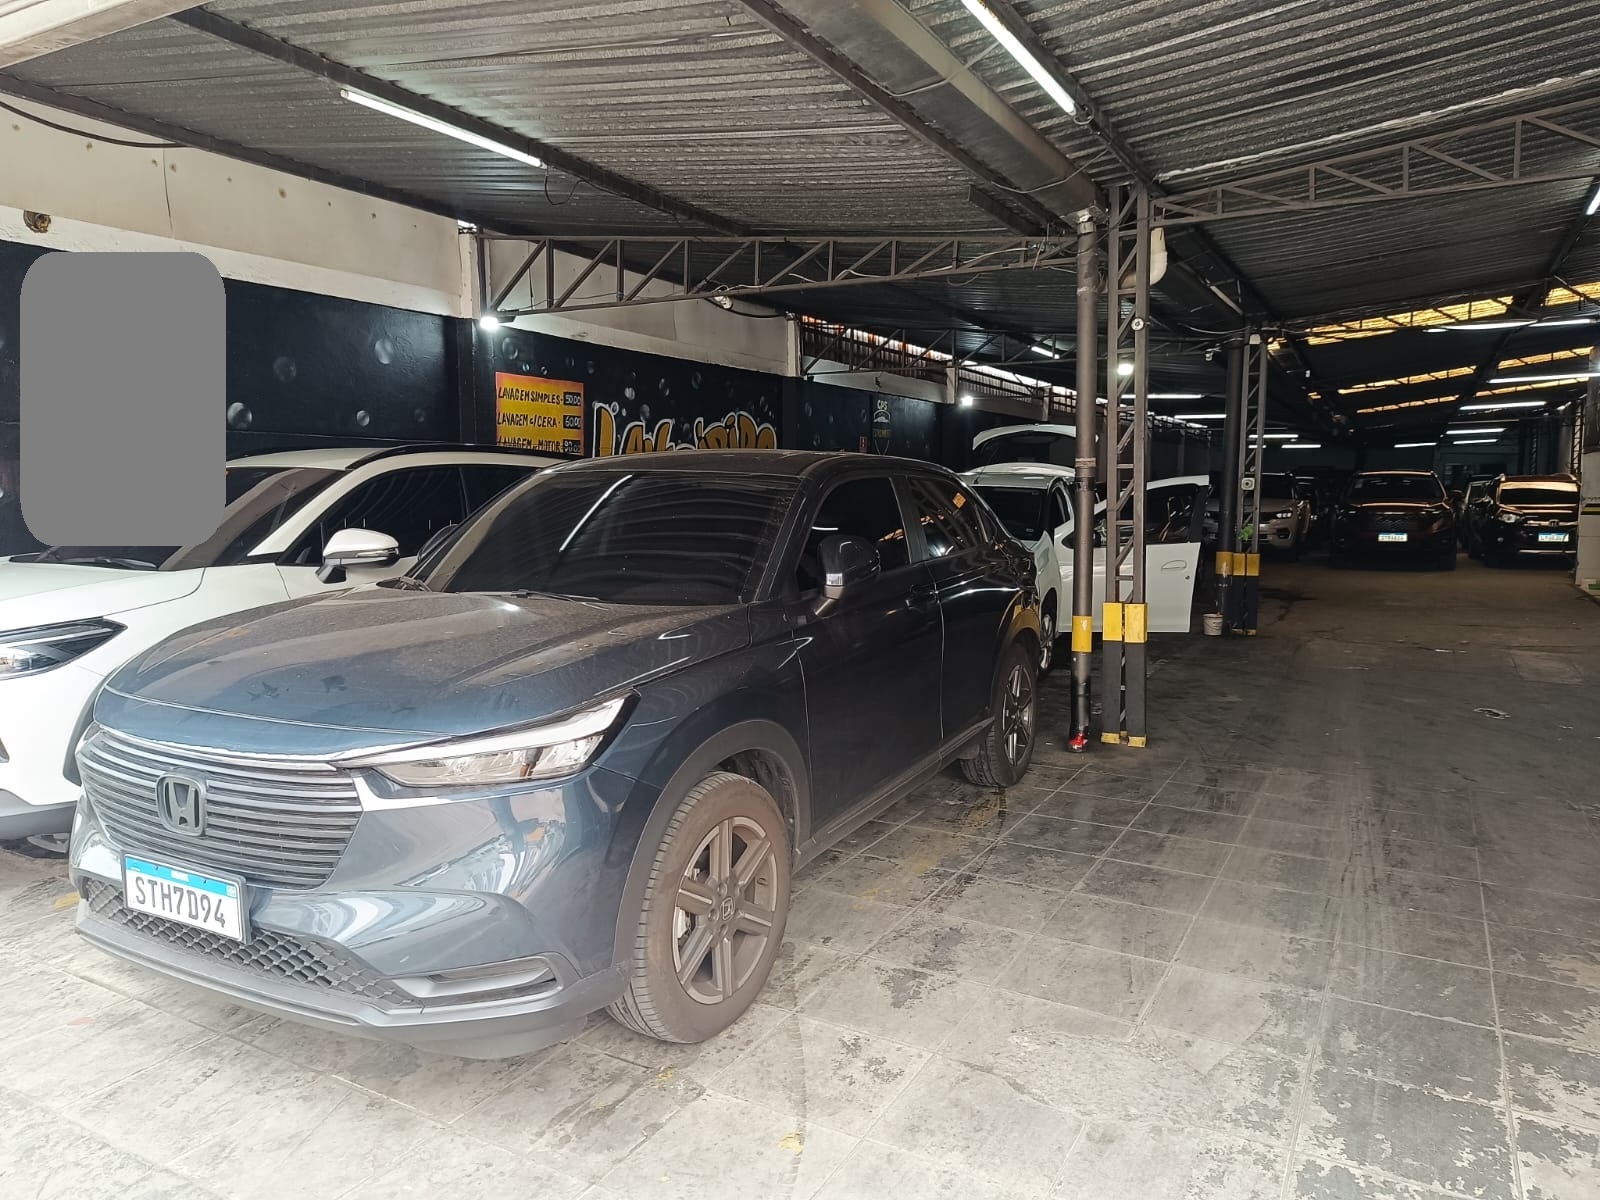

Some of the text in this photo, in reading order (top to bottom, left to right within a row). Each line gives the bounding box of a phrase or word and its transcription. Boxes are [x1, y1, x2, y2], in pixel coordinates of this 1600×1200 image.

[498, 387, 530, 402] LAVAGEM
[497, 412, 529, 427] LAVAGEM
[135, 876, 226, 929] STH7D94
